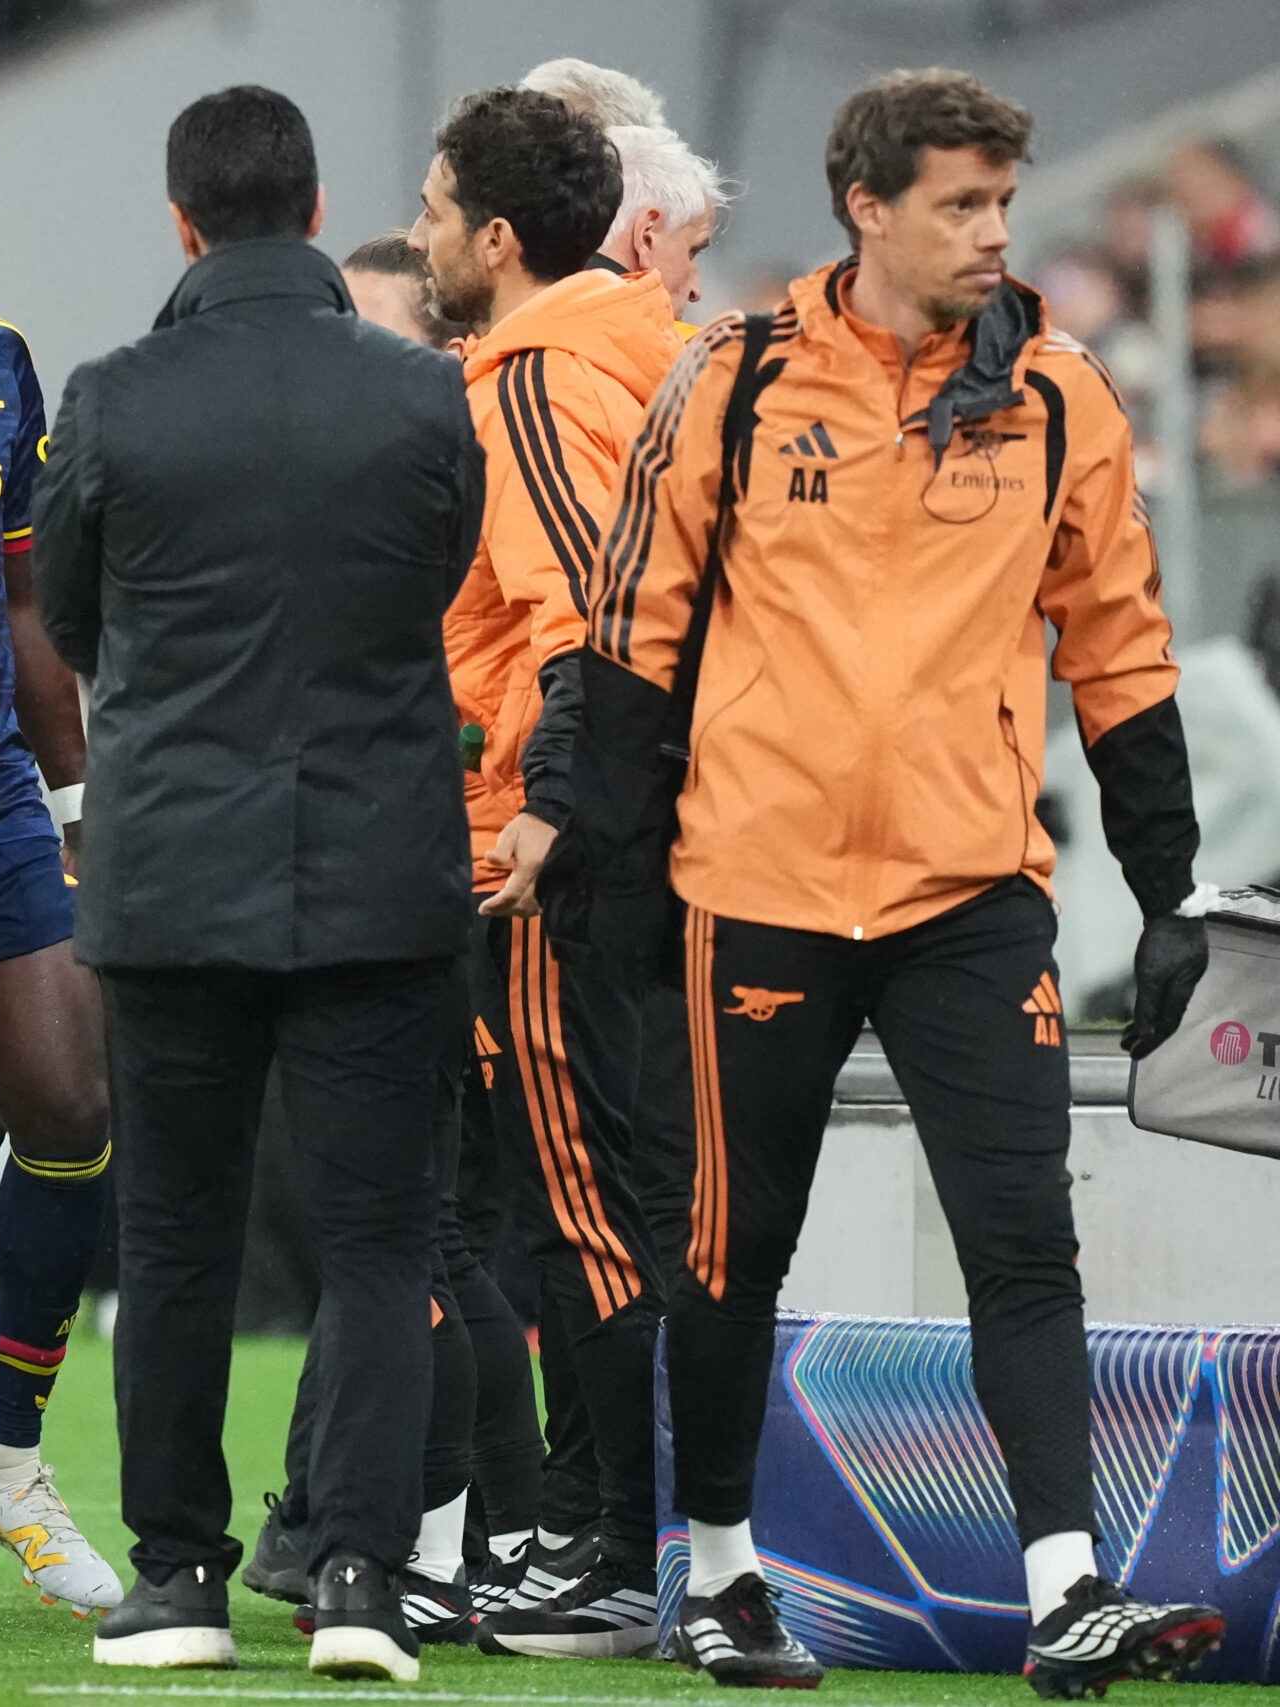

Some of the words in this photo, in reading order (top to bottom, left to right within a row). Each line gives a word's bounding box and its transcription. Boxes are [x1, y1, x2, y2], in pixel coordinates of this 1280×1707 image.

[788, 467, 829, 504] AA
[1034, 1014, 1062, 1048] AA
[1256, 1074, 1280, 1101] LI
